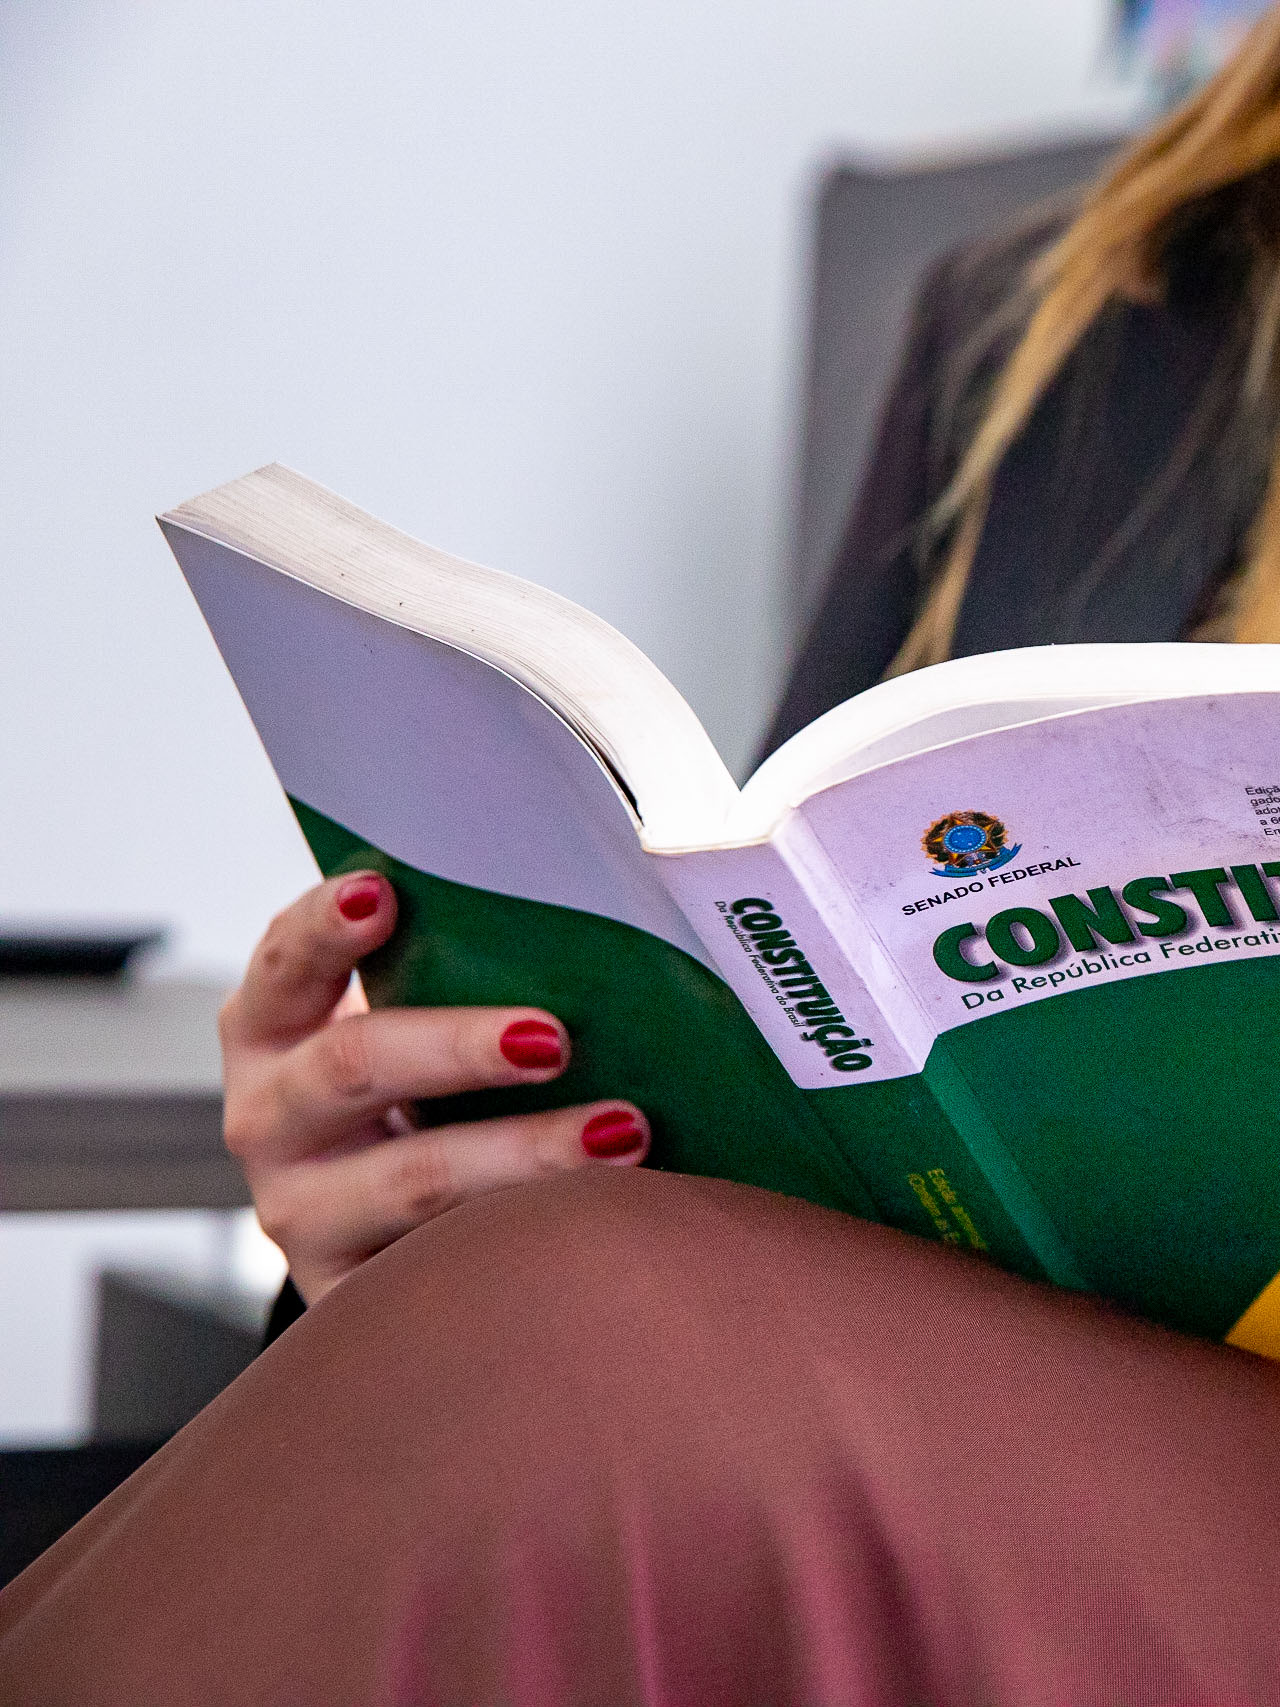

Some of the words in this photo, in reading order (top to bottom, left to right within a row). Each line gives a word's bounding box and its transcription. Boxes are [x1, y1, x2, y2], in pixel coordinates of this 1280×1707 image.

[1250, 795, 1280, 807] gado
[902, 881, 984, 916] SENADO
[989, 856, 1081, 888] FEDERAL
[714, 901, 727, 913] Da
[724, 915, 753, 953] República
[749, 954, 779, 994] Federativa
[775, 995, 788, 1006] do
[783, 1007, 806, 1028] Brasil
[731, 898, 873, 1072] CONSTITUIÇÃO
[961, 989, 1005, 1010] Da
[1011, 950, 1152, 996] República
